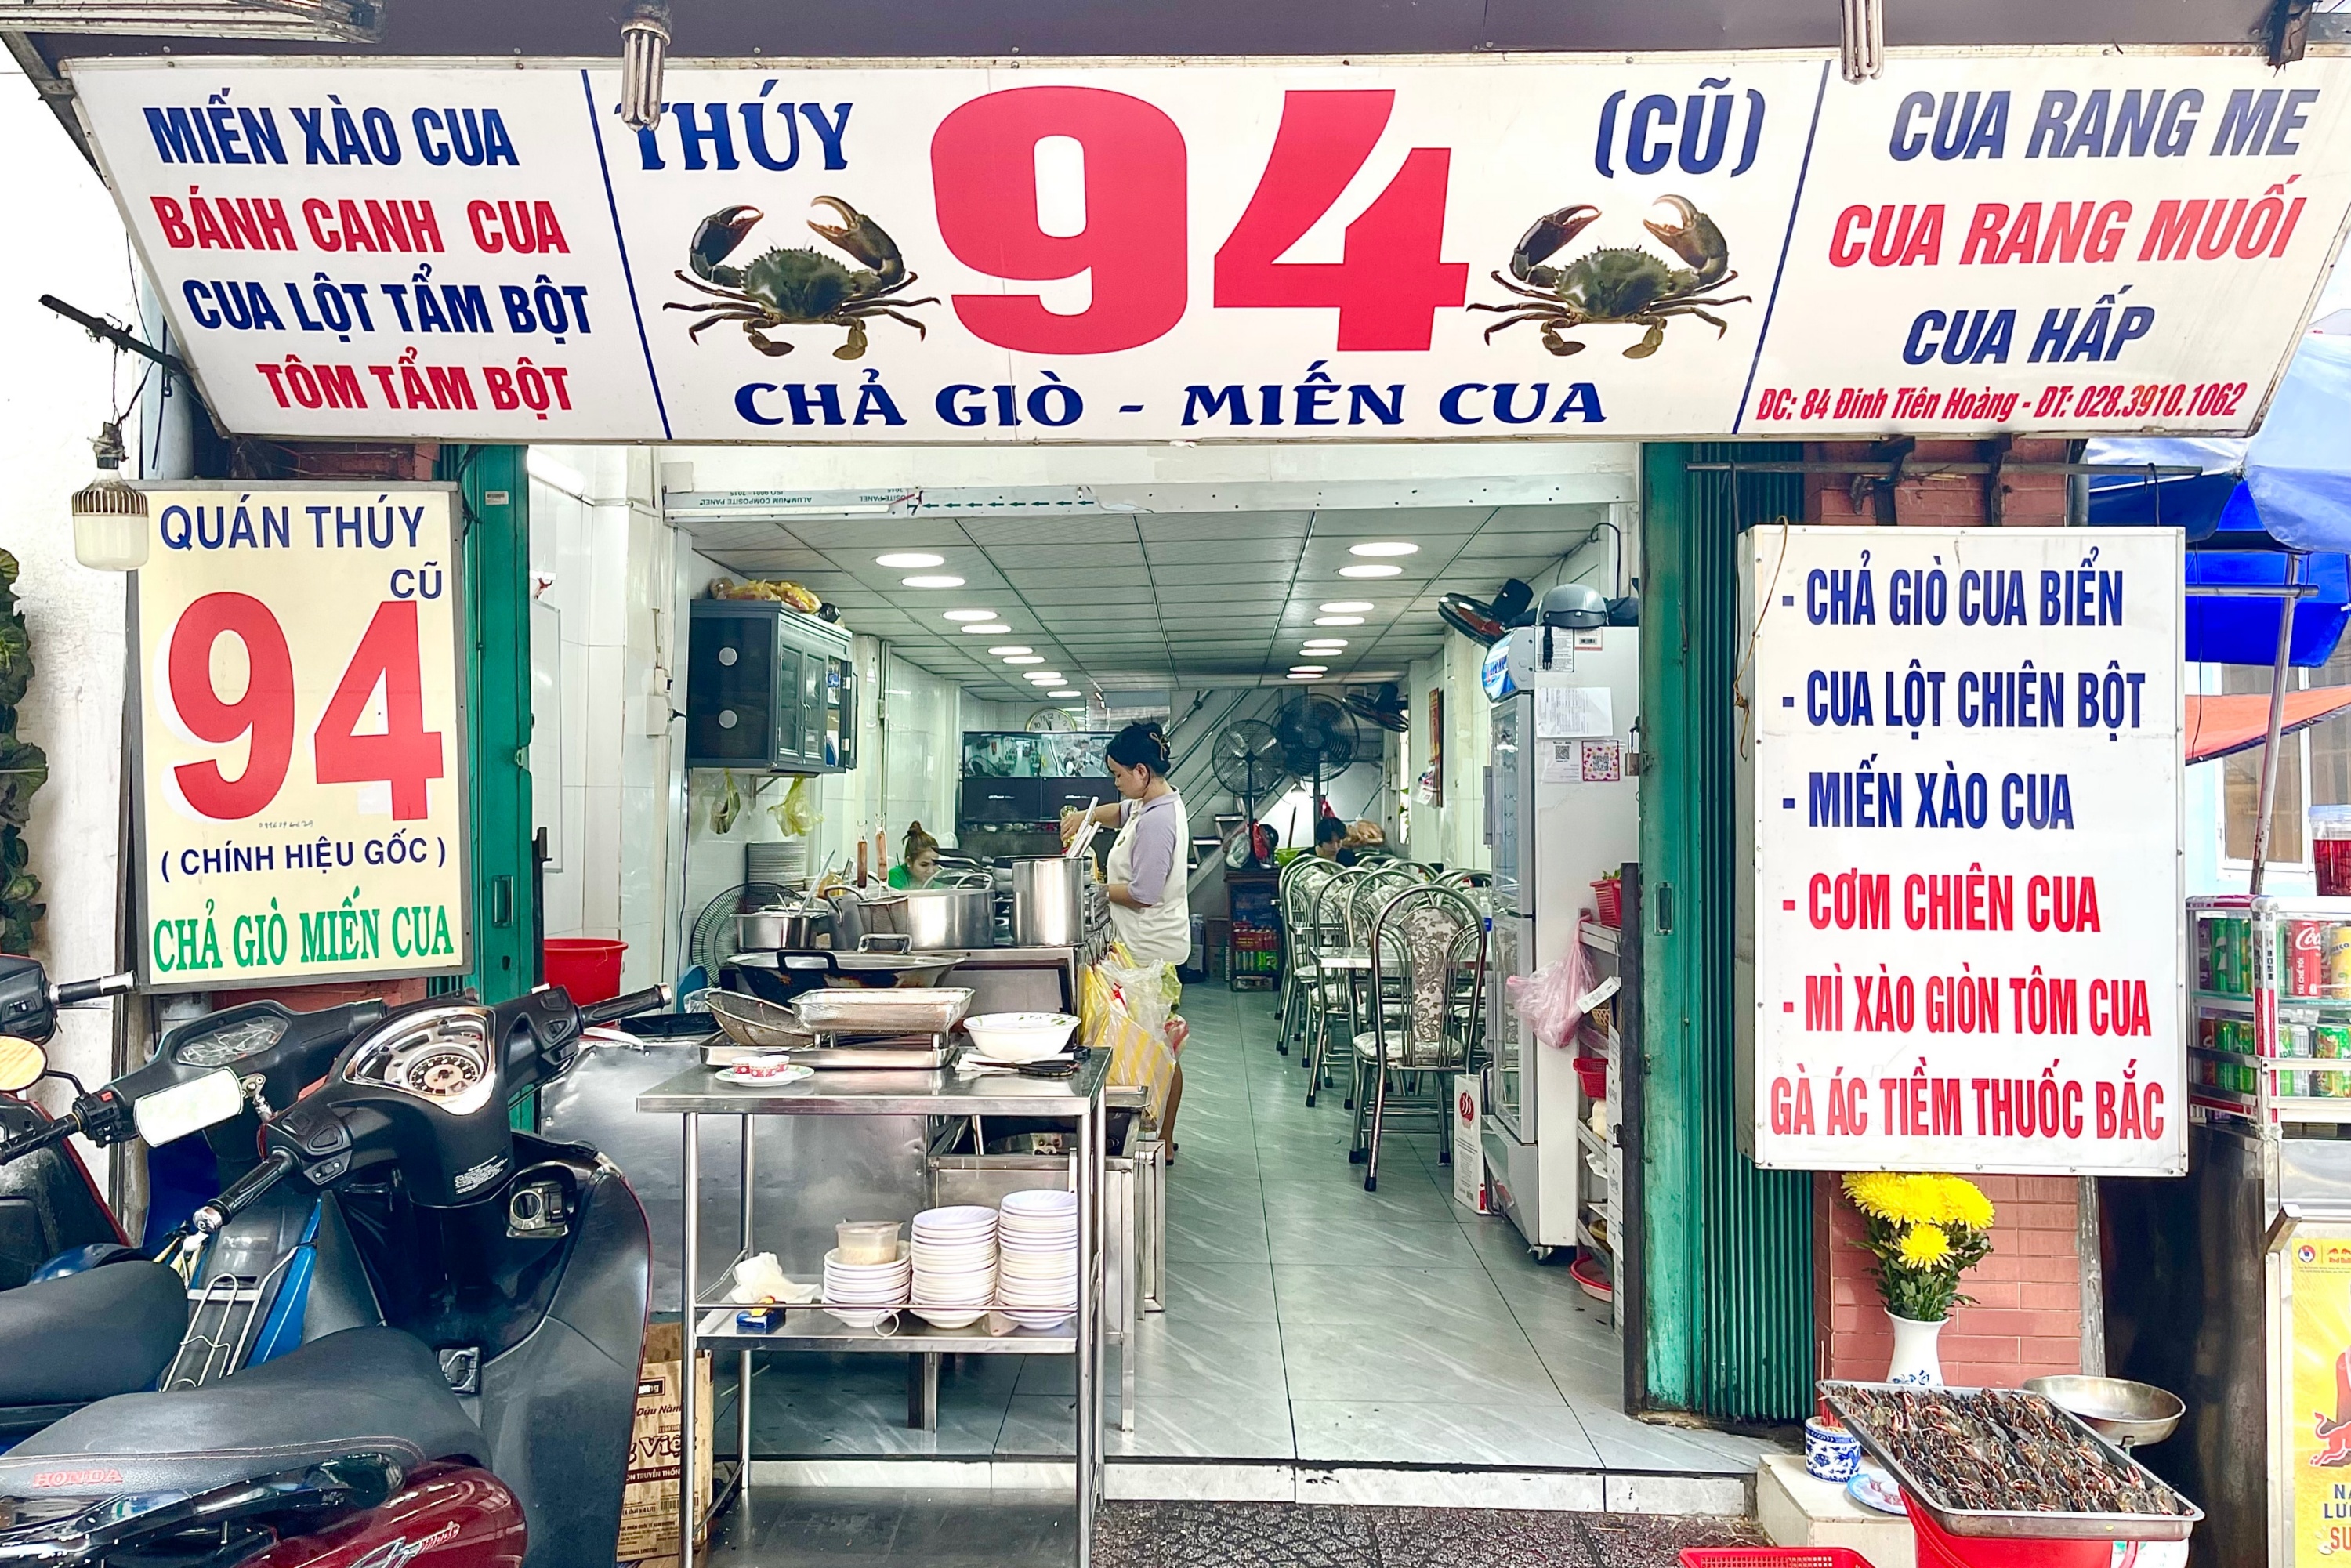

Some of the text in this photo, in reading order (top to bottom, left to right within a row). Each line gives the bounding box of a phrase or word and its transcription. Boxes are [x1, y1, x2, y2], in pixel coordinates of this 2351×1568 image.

[142, 88, 520, 166] MIẾN XÀO CUA
[614, 77, 853, 172] THÚY
[1595, 77, 1765, 179] (CŨ)
[1889, 89, 2320, 161] CUA RANG ME
[150, 185, 571, 254] BÁNH CANH CUA
[930, 85, 1469, 355] 94
[1829, 174, 2307, 268] CUA RANG MUỐI
[183, 263, 591, 344] CUA LỘT TẨM BỘT
[1903, 284, 2155, 365] CUA HẤP
[255, 346, 572, 420] TÔM TẨM BỘT
[734, 368, 907, 425] CHẢ
[936, 371, 1083, 426] GIÒ
[1181, 360, 1406, 426] MIẾN
[1440, 382, 1607, 425] CUA
[1756, 388, 1797, 420] ĐC:
[1800, 389, 1831, 420] 84
[1891, 386, 1941, 418] Tiên
[1941, 386, 2020, 422] Hoàng
[2034, 386, 2074, 418] ĐT:
[2074, 382, 2248, 418] 028.3910.1062
[161, 494, 424, 551] QUÁN THÚY
[390, 561, 441, 599] CŨ
[1807, 549, 1875, 625] CHẢ
[1889, 556, 1947, 626] GIÒ
[1959, 570, 2027, 626] CUA
[2040, 546, 2123, 626] BIỂN
[168, 592, 444, 821] 94
[1807, 670, 1874, 726] CUA
[1886, 659, 1946, 740] LỘT
[1958, 660, 2063, 727] CHIÊN
[2078, 660, 2146, 741] BỘT
[1809, 753, 1902, 827] MIẾN
[1915, 760, 1987, 829] XÀO
[2002, 773, 2074, 830] CUA
[181, 840, 273, 875] CHÍNH
[285, 836, 353, 874] HIỆU
[364, 828, 426, 864] GỐC
[154, 886, 454, 972] CHẢ GIÒ MIẾN CUA
[1809, 867, 1890, 930] CƠM
[1904, 862, 2013, 931] CHIÊN
[2027, 875, 2101, 932] CUA
[1806, 963, 1842, 1031] MÌ
[1854, 963, 1914, 1033] XÀO
[1926, 962, 1999, 1034] GIÒN
[2009, 965, 2078, 1035] TÔM
[2089, 979, 2151, 1037] CUA
[1771, 1056, 2164, 1140] GÀ ÁC TIỀM THUỐC BẮC
[33, 1469, 123, 1487] HONDA
[639, 1435, 681, 1458] Việ
